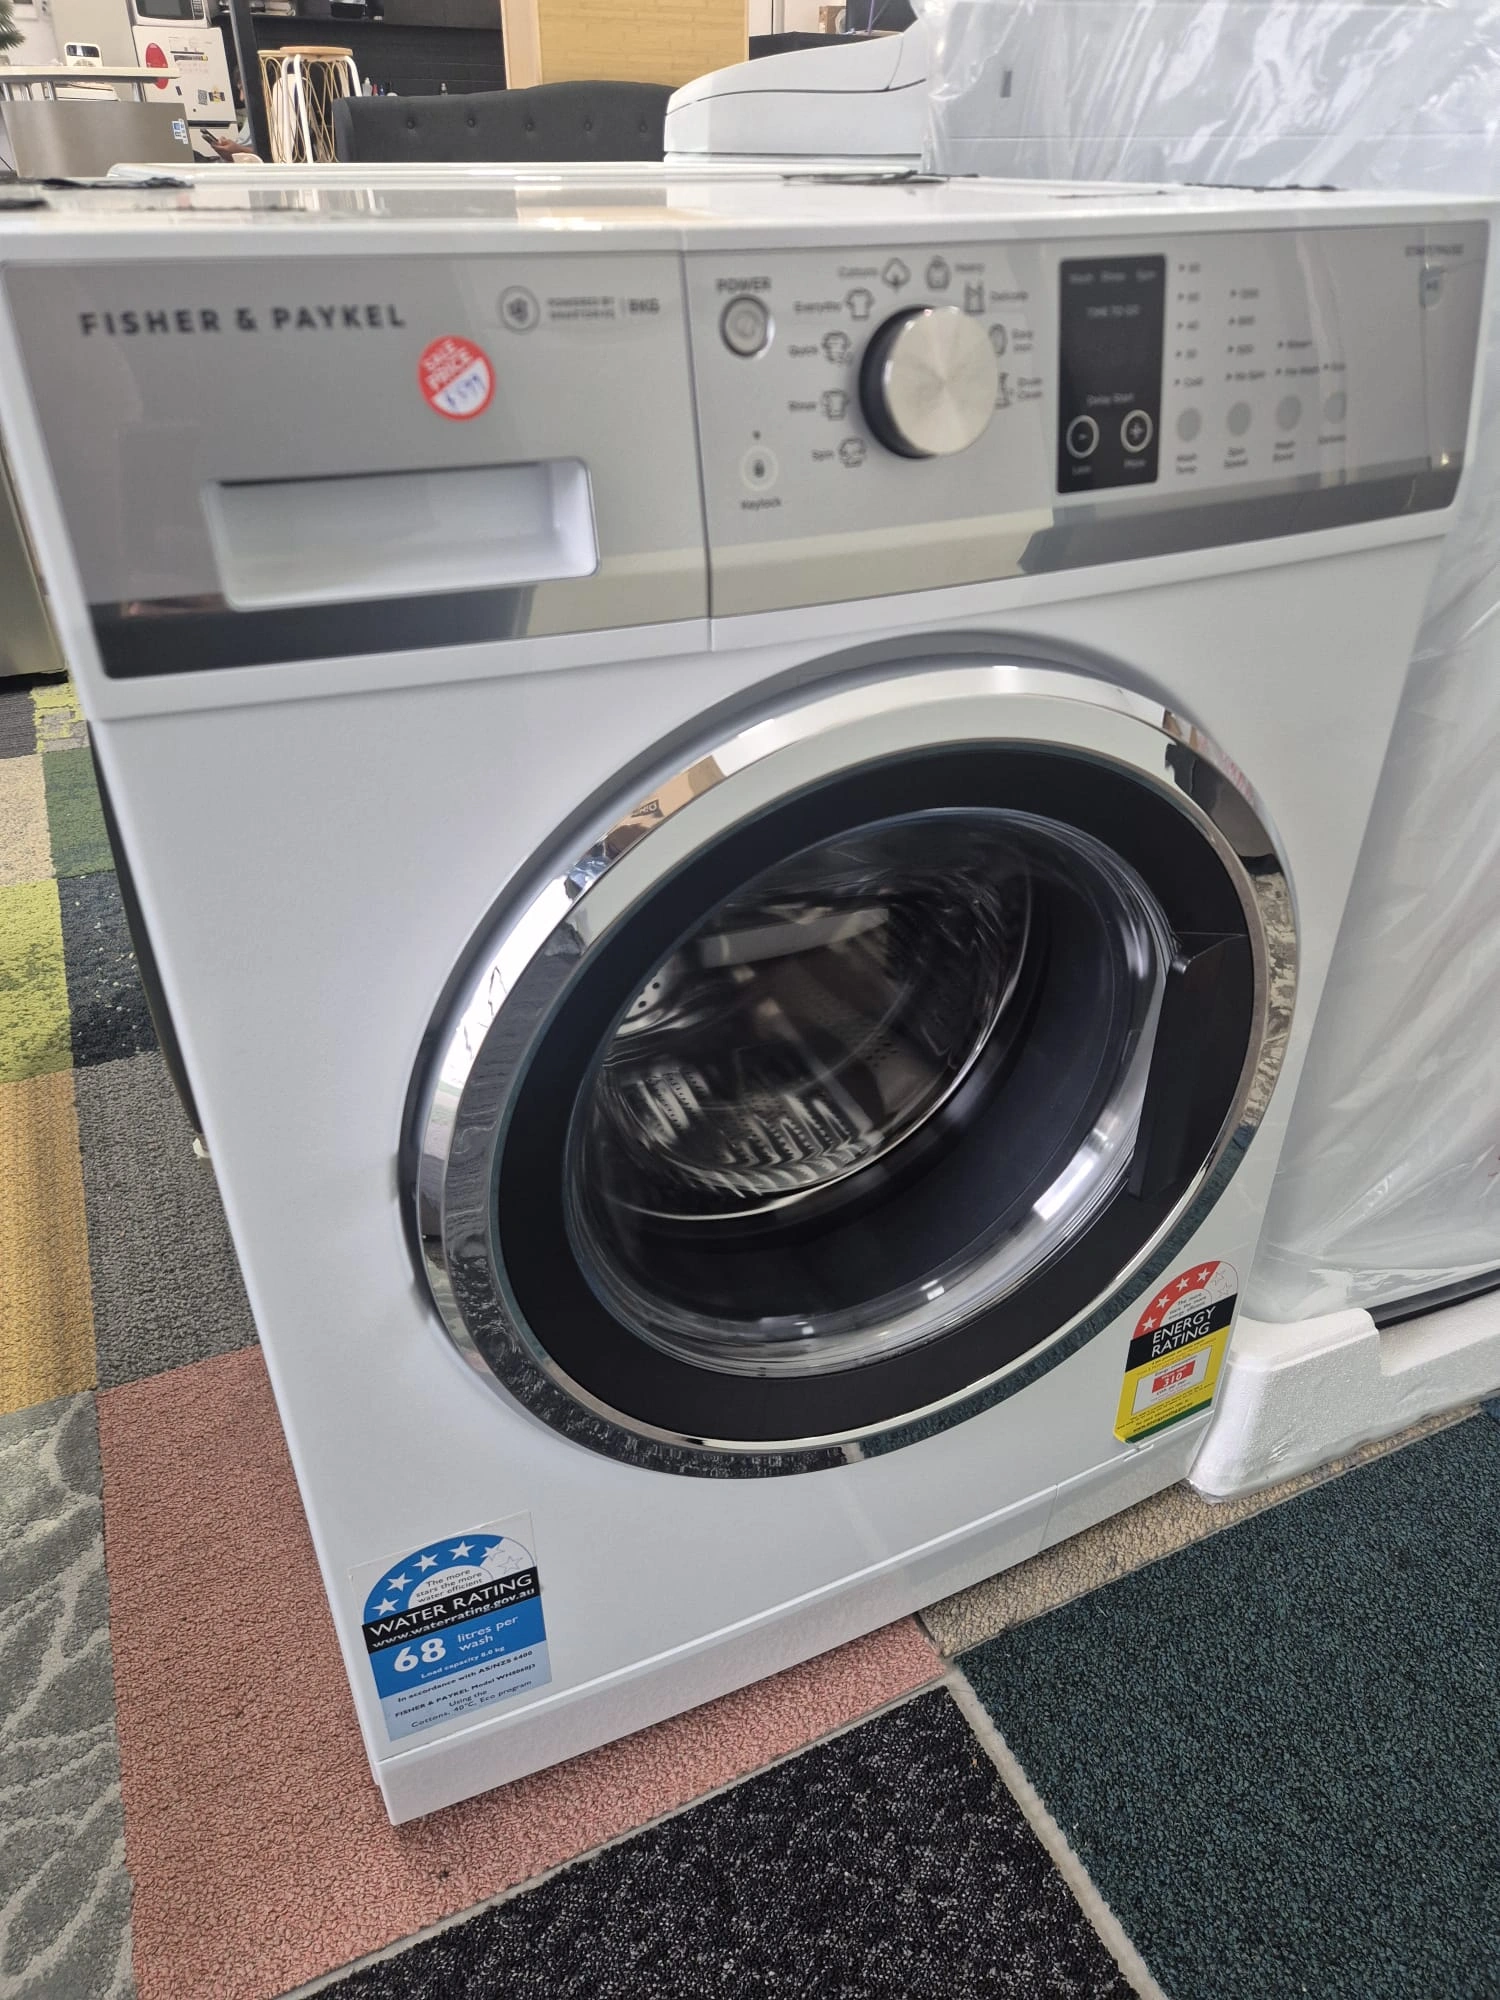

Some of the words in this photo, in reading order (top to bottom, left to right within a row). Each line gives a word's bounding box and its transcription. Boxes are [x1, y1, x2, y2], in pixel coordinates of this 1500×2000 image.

[716, 276, 772, 295] POWER
[79, 308, 222, 336] FISHER
[236, 307, 259, 332] &
[271, 303, 406, 332] PAYKEL
[1152, 1305, 1217, 1345] ENERGY
[1151, 1321, 1211, 1358] RATING
[1163, 1371, 1183, 1387] 310
[416, 1587, 438, 1598] stars
[441, 1581, 456, 1590] the
[458, 1572, 482, 1583] more
[417, 1591, 444, 1603] water
[447, 1578, 483, 1594] efficient
[426, 1578, 444, 1587] The
[446, 1570, 471, 1581] more
[369, 1604, 447, 1636] WATER
[452, 1574, 533, 1610] RATING
[372, 1588, 535, 1648] www.waterrating.gov.au
[457, 1626, 492, 1643] litres
[496, 1616, 519, 1632] per
[394, 1637, 447, 1672] 68
[459, 1634, 494, 1652] wash
[408, 1679, 457, 1698] accordance
[458, 1671, 477, 1681] with
[478, 1658, 512, 1674] AS/NZS
[420, 1667, 443, 1679] Load
[444, 1656, 479, 1671] capacity
[394, 1702, 427, 1718] FISHER
[436, 1688, 470, 1703] PAYKEL
[471, 1678, 495, 1690] Model
[448, 1696, 473, 1708] Using
[473, 1690, 488, 1699] the
[479, 1694, 496, 1704] Eco
[498, 1680, 532, 1697] program
